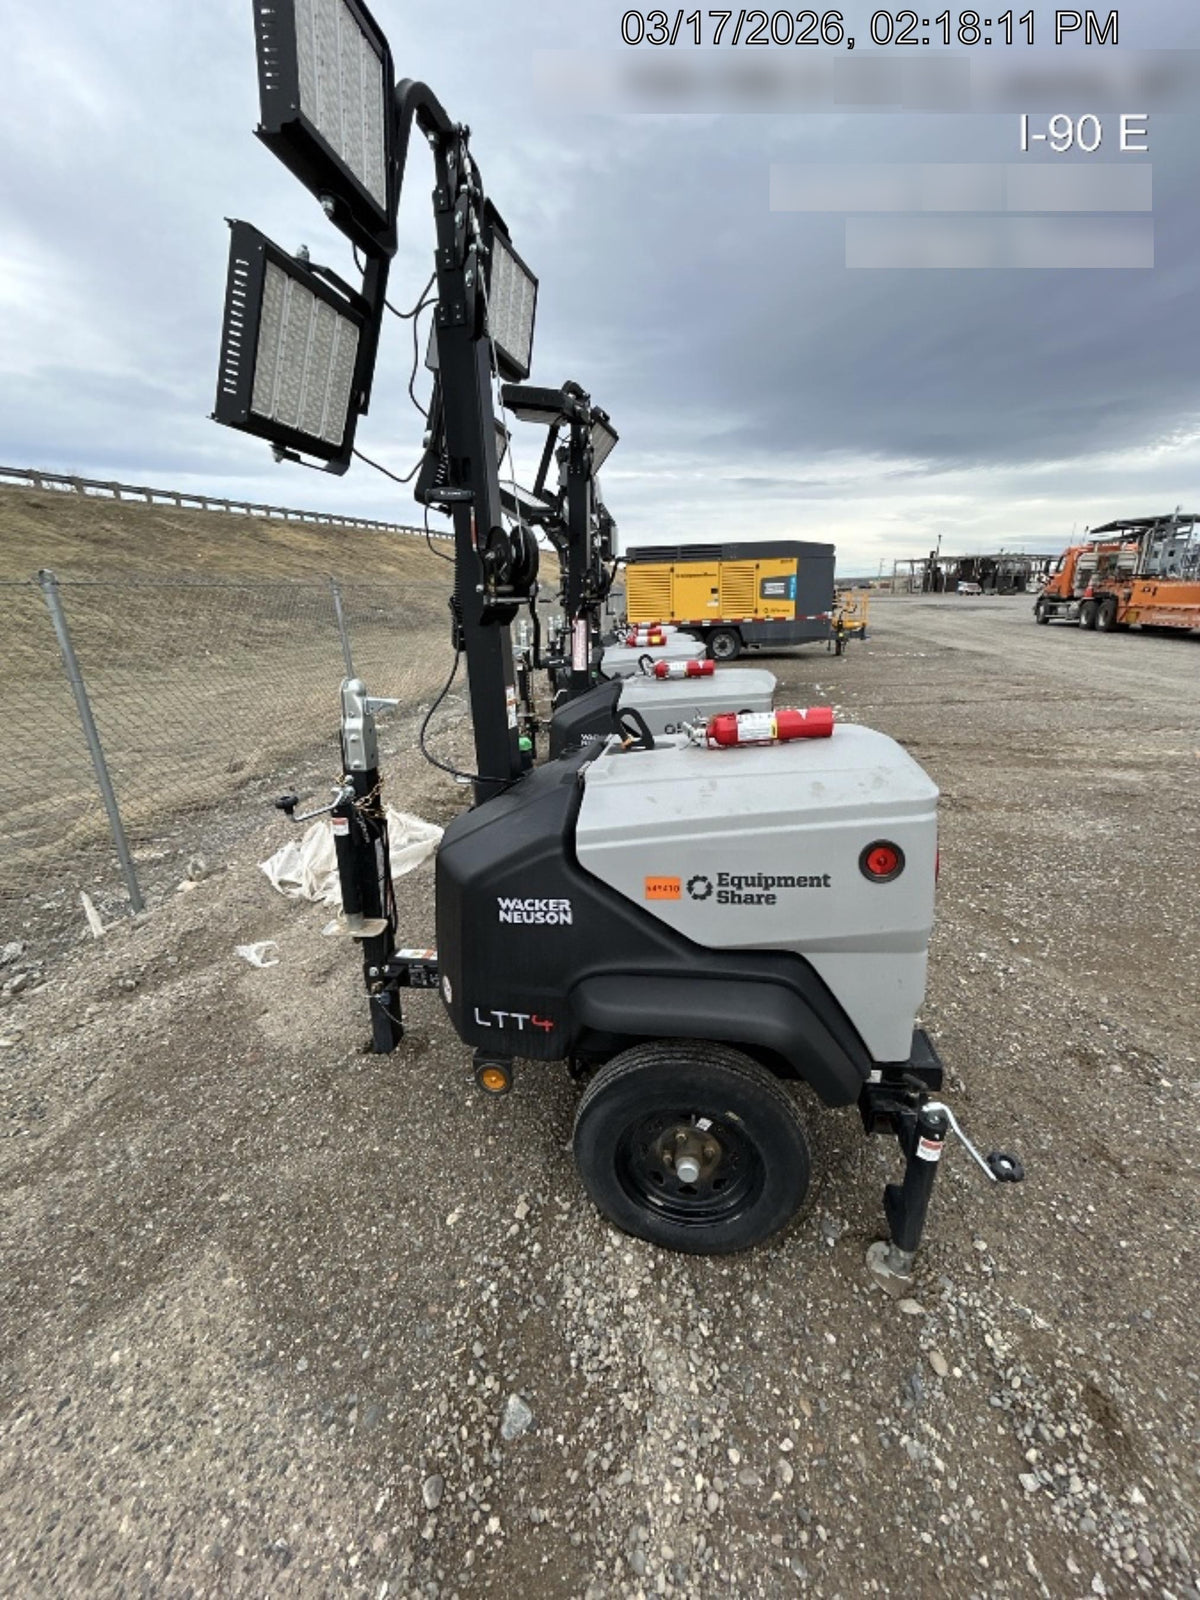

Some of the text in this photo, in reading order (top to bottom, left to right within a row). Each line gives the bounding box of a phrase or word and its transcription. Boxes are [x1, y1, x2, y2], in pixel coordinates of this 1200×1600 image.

[717, 872, 831, 891] Equipment
[497, 897, 571, 911] WACKER
[717, 890, 777, 905] Share
[499, 910, 573, 925] NEUSON
[474, 1007, 554, 1032] LTT4
